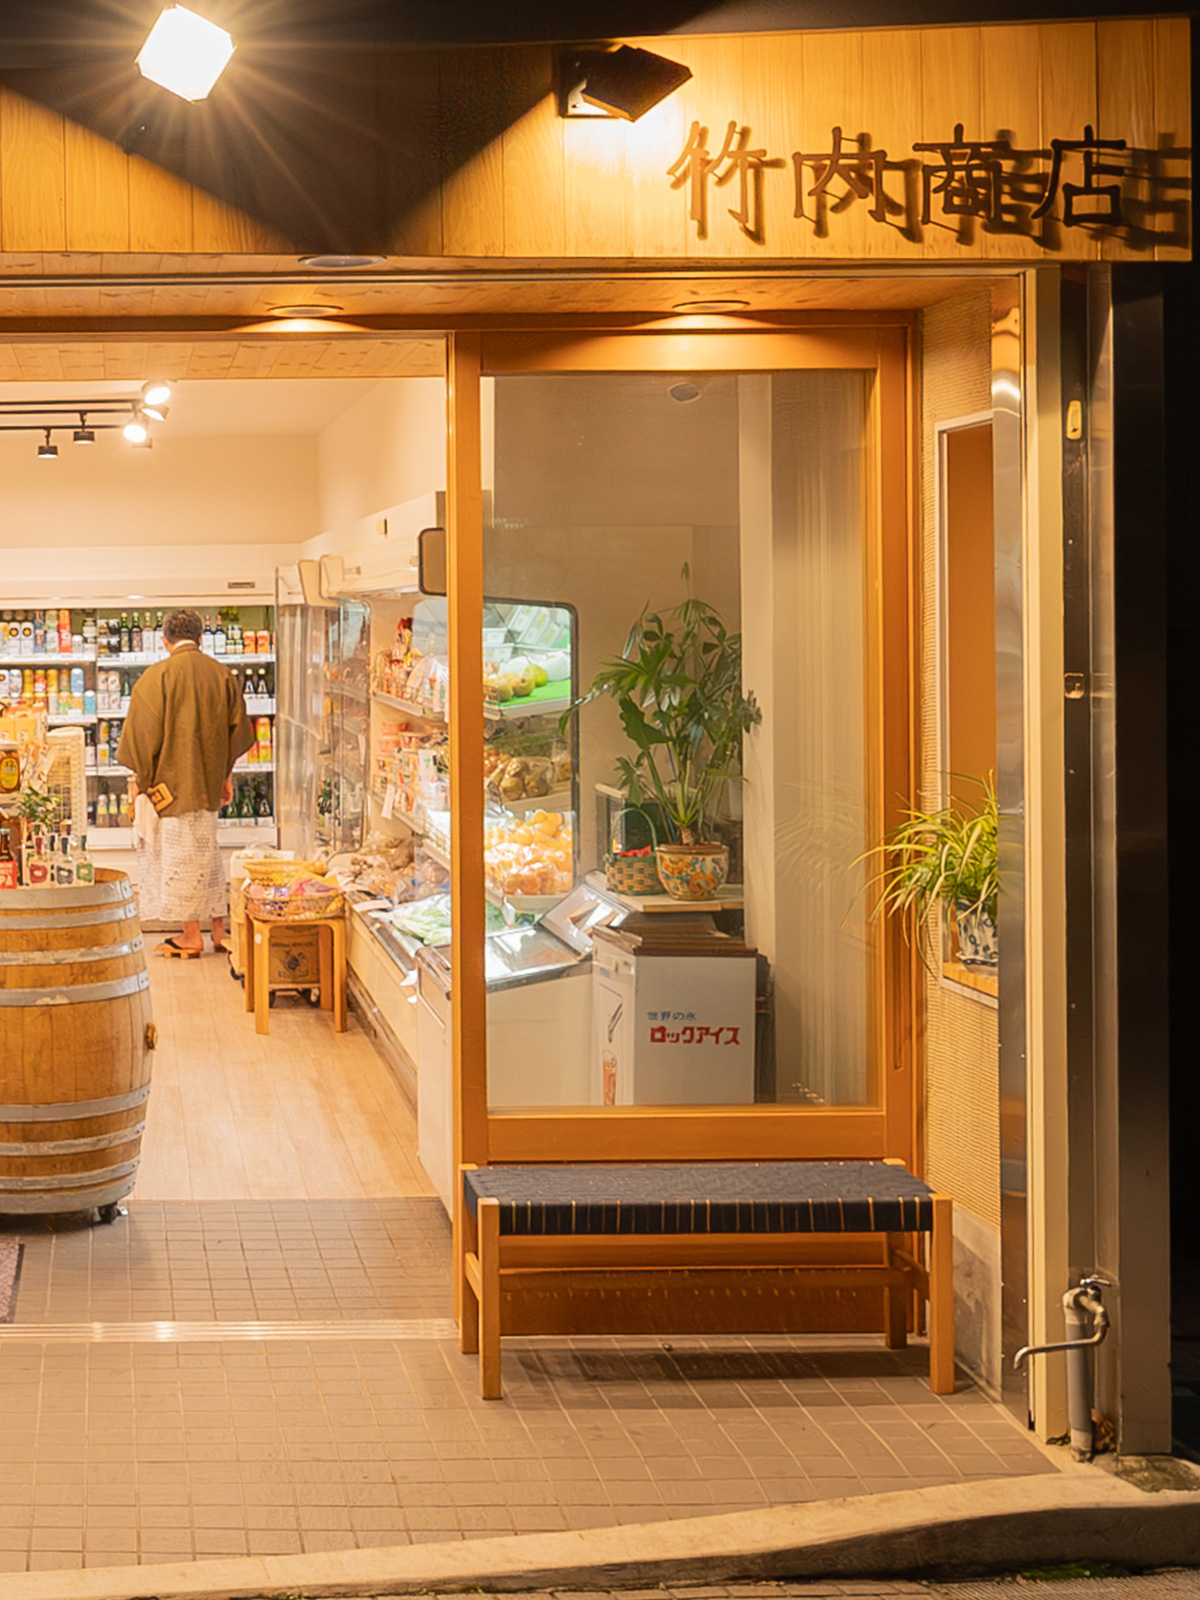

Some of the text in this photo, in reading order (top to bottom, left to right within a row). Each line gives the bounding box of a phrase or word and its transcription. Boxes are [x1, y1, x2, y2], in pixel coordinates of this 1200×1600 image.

[667, 119, 1127, 227] 竹内商店
[650, 1025, 740, 1045] ロックアイス
